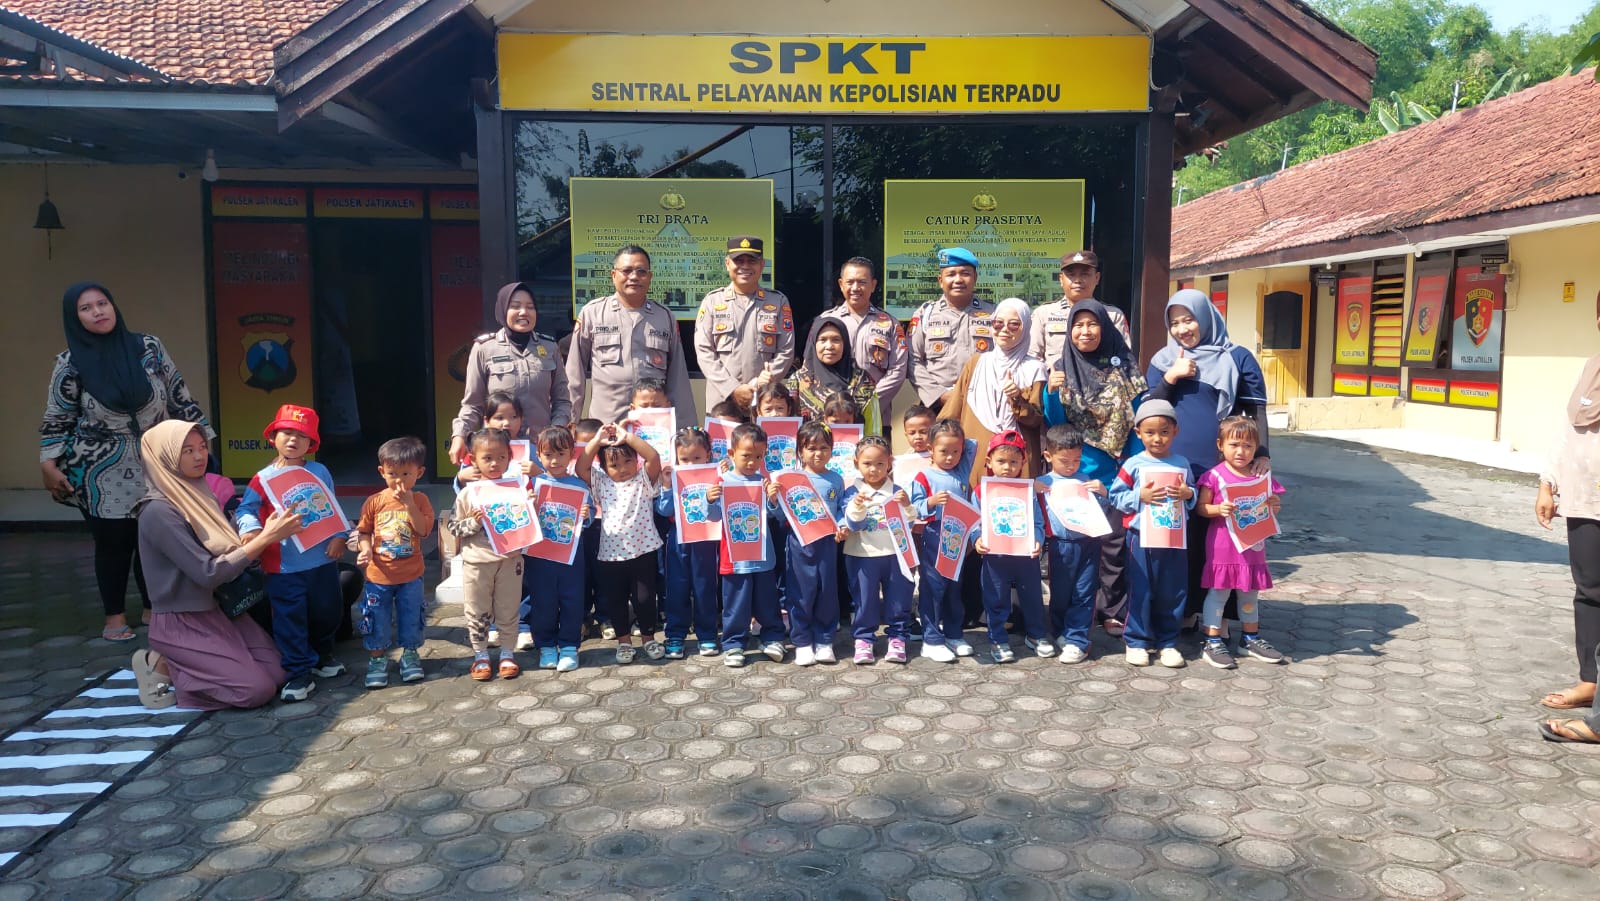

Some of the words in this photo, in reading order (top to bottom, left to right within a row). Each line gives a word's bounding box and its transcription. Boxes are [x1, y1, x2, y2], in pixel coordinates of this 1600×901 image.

[729, 42, 926, 75] SPKT
[591, 82, 693, 102] SENTRAL
[697, 82, 822, 103] PELAYANAN
[829, 83, 960, 103] KEPOLISIAN
[964, 83, 1061, 102] TERPADU
[326, 198, 362, 208] POLSEK
[364, 199, 416, 209] JATIKALEN
[637, 214, 660, 224] TRI
[665, 215, 709, 224] BRATA
[926, 215, 970, 225] CATUR
[975, 215, 1042, 225] PRASETYA
[229, 439, 262, 450] POLSEK
